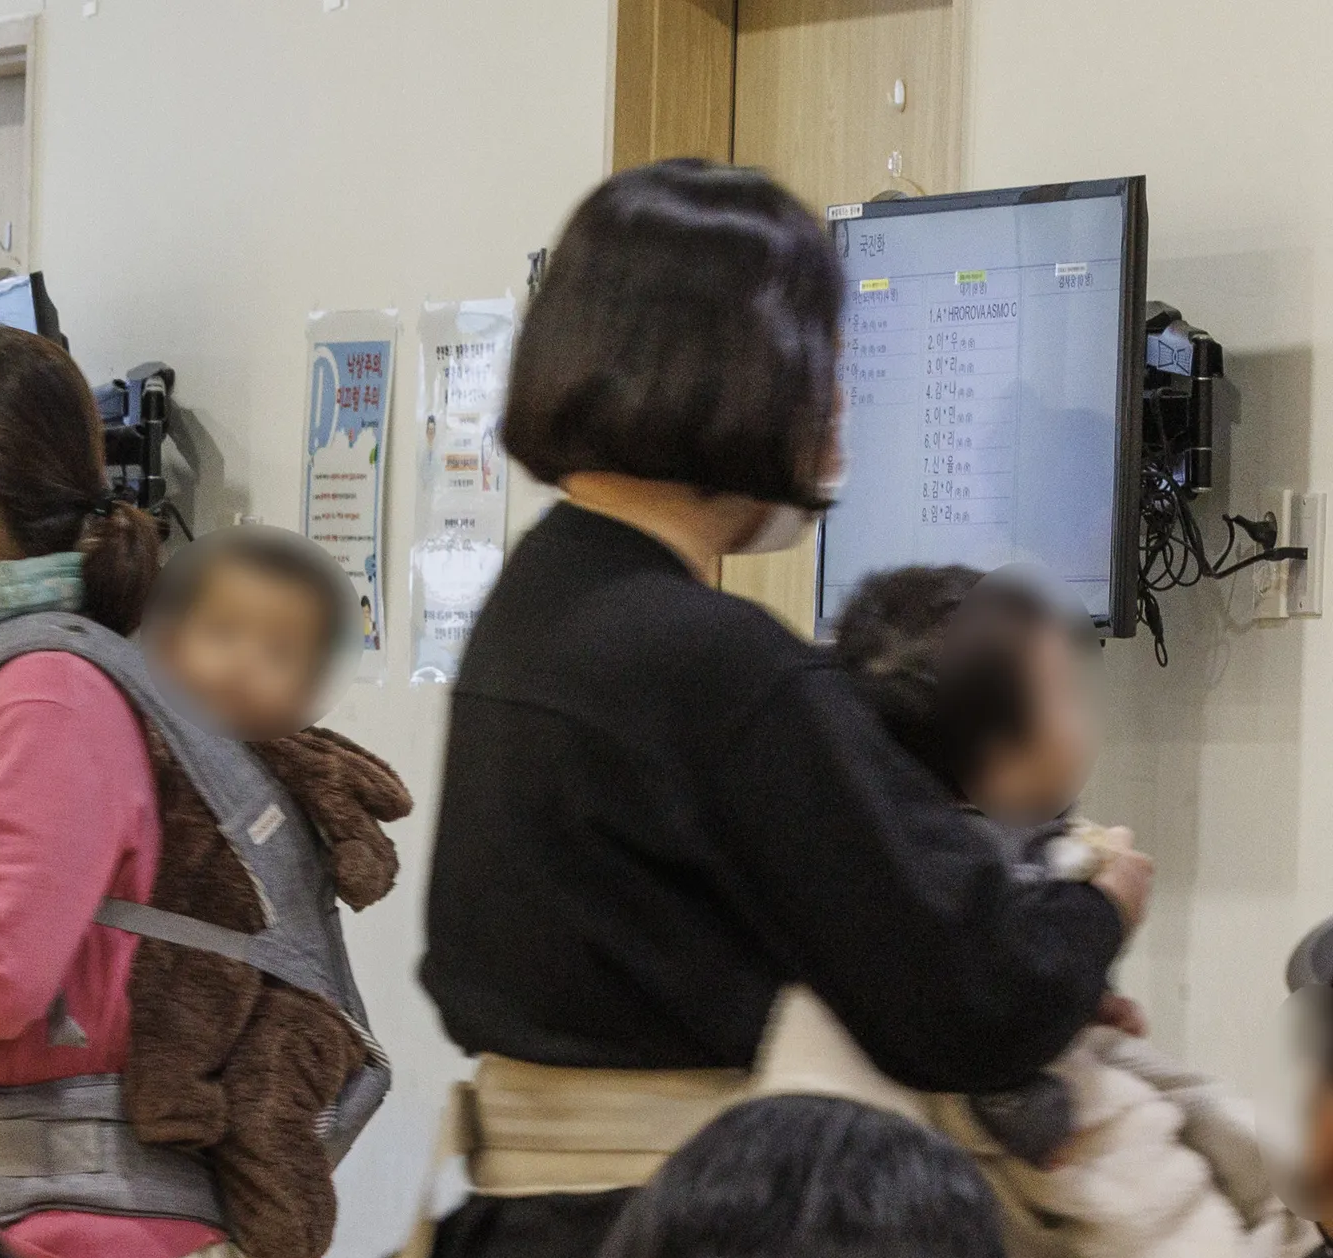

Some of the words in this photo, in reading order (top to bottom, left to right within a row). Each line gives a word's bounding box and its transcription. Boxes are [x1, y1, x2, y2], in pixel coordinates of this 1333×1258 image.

[859, 232, 885, 258] 국진화
[336, 385, 361, 412] 미끄럼
[363, 384, 380, 412] 주의
